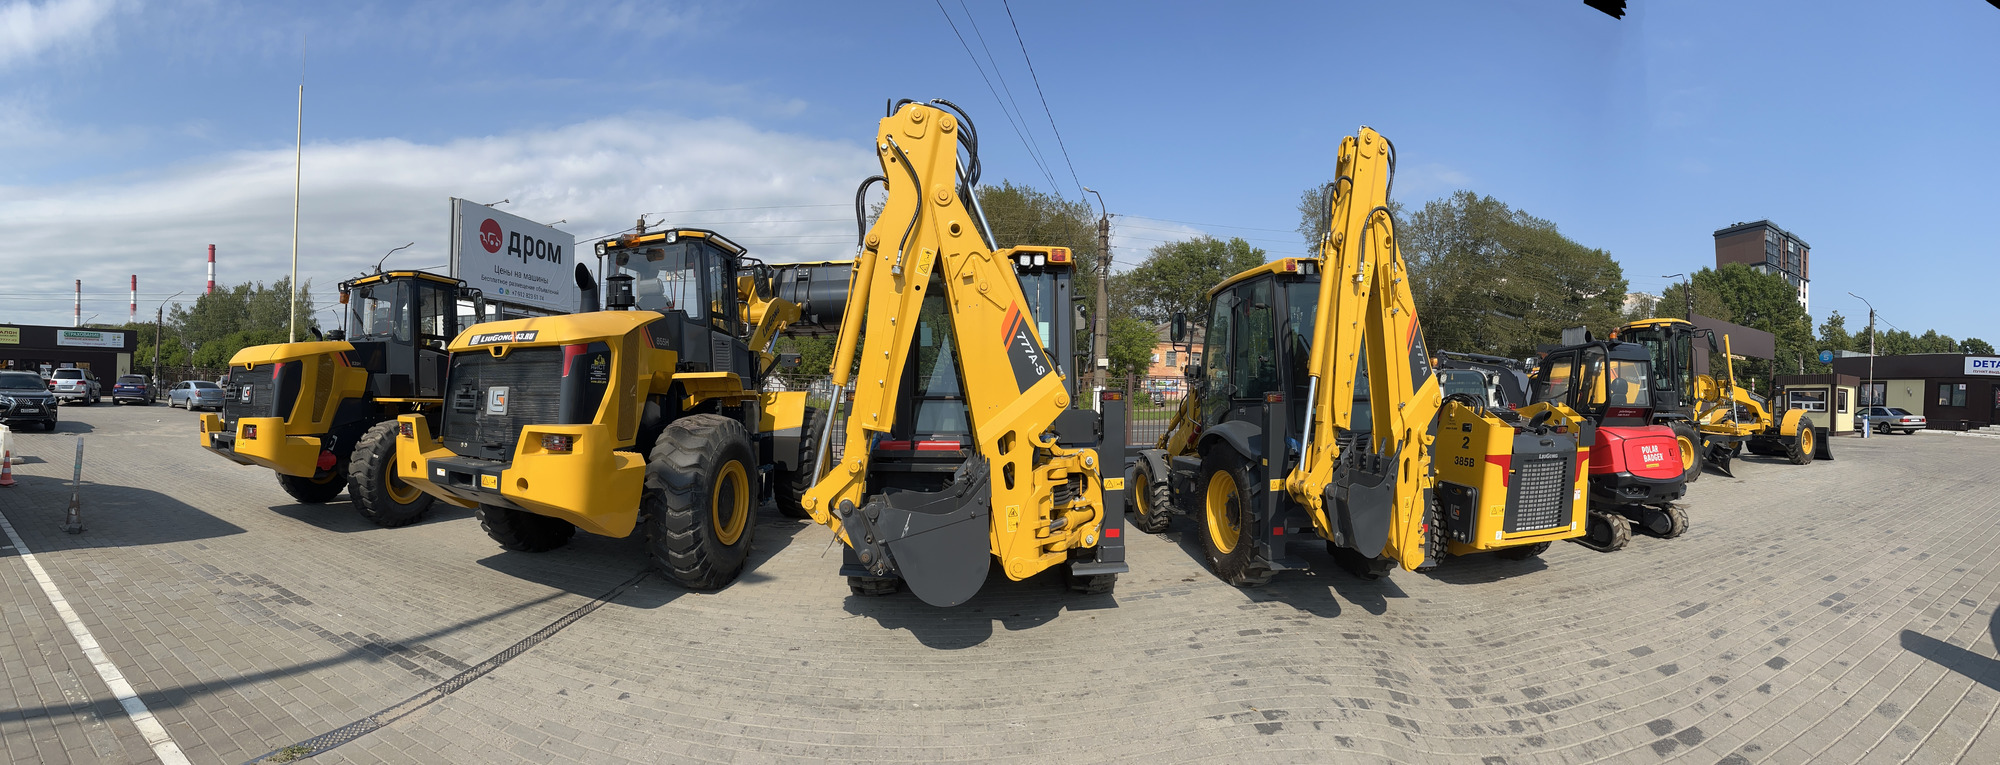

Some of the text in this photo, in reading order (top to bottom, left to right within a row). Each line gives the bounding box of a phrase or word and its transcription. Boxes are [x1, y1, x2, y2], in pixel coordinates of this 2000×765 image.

[507, 230, 562, 265] дром
[480, 274, 508, 286] Бесплатное
[508, 280, 535, 291] размещение
[494, 264, 549, 284] Цены на машины
[1016, 331, 1046, 376] 777A-S
[1416, 342, 1427, 376] 777A
[1462, 436, 1470, 449] 2
[1641, 445, 1658, 454] POLAR
[1454, 456, 1474, 468] 385B
[1643, 453, 1664, 462] BADGER
